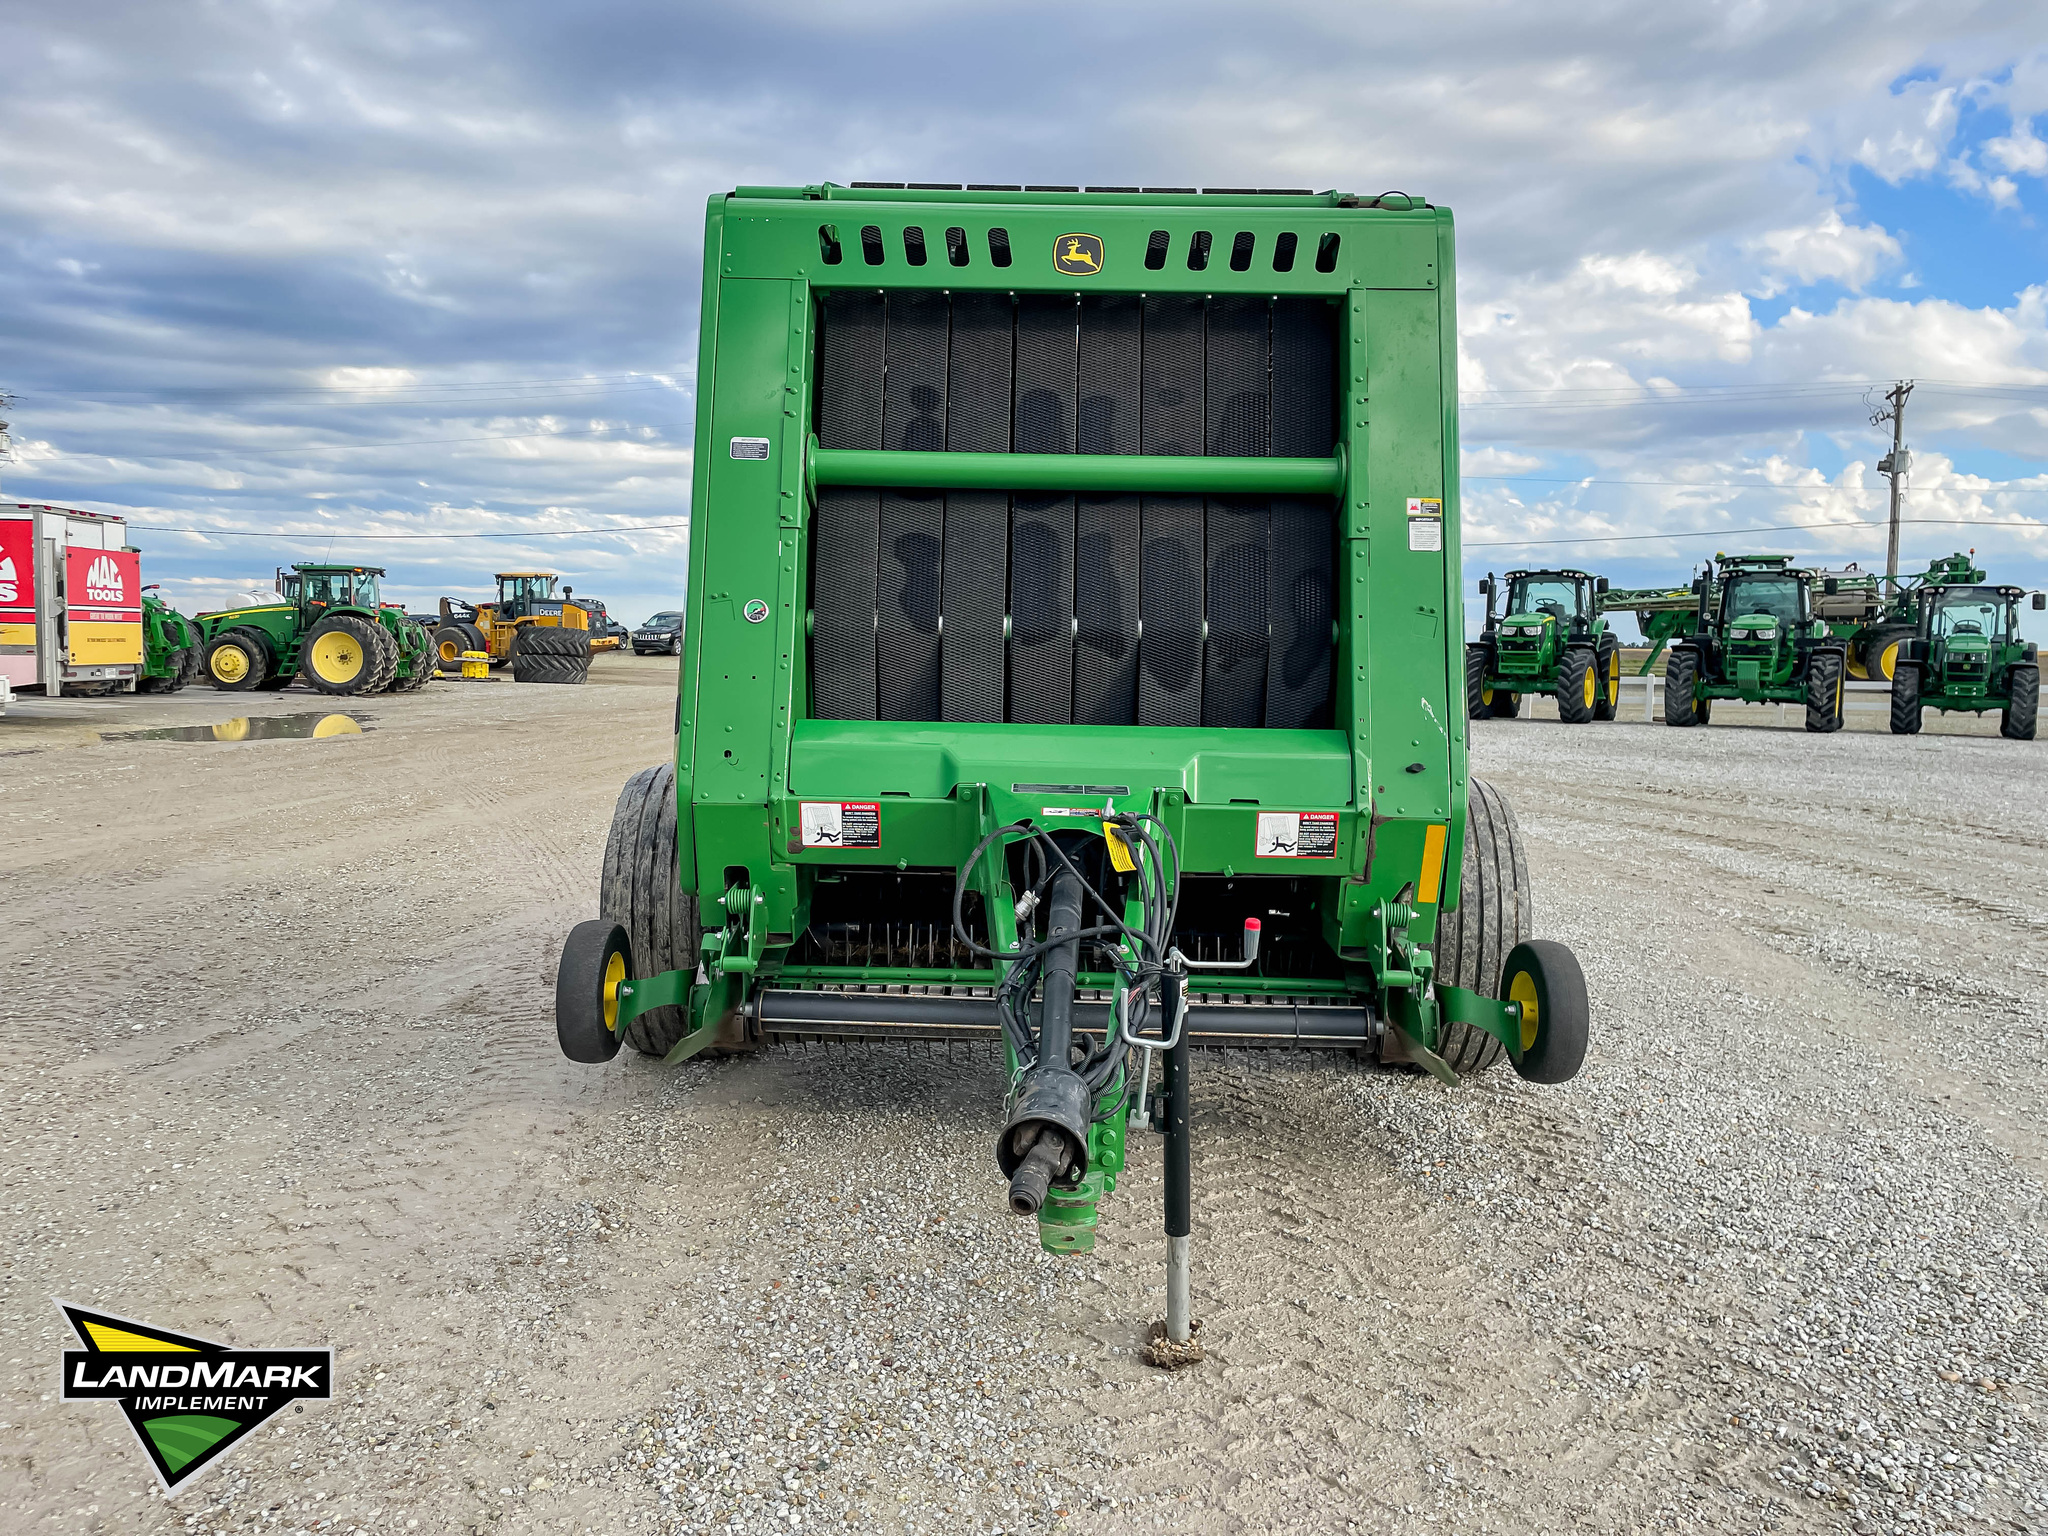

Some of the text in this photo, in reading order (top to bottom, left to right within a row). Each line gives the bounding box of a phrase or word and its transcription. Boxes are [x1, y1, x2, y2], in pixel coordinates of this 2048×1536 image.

[86, 555, 123, 589] MAC
[86, 589, 124, 602] TOOLS
[539, 608, 562, 617] DEERE
